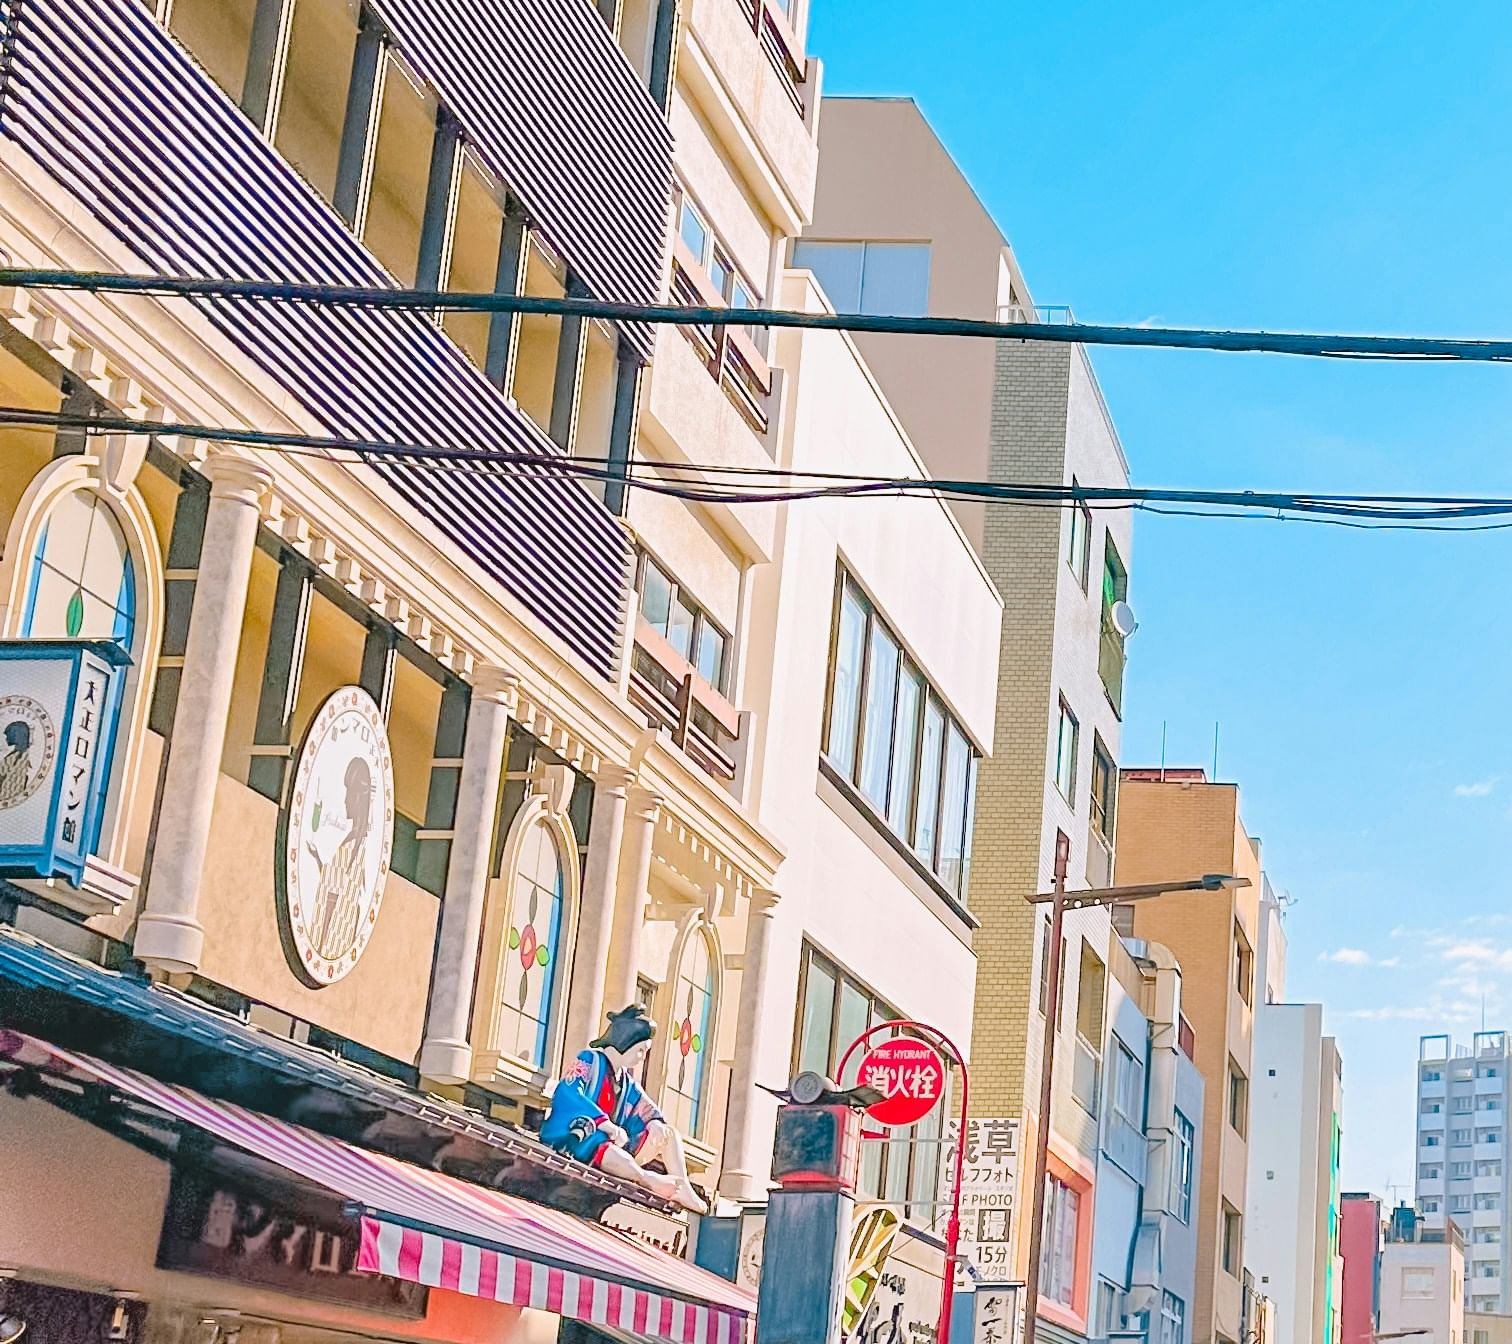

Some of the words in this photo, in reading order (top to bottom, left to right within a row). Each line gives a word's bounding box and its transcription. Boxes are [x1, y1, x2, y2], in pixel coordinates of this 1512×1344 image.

[872, 1049, 891, 1059] FIRE
[893, 1049, 931, 1059] HYDRANT
[865, 1065, 938, 1098] 消火栓
[972, 1194, 1012, 1205] PHOTO
[976, 1246, 1007, 1264] 15分
